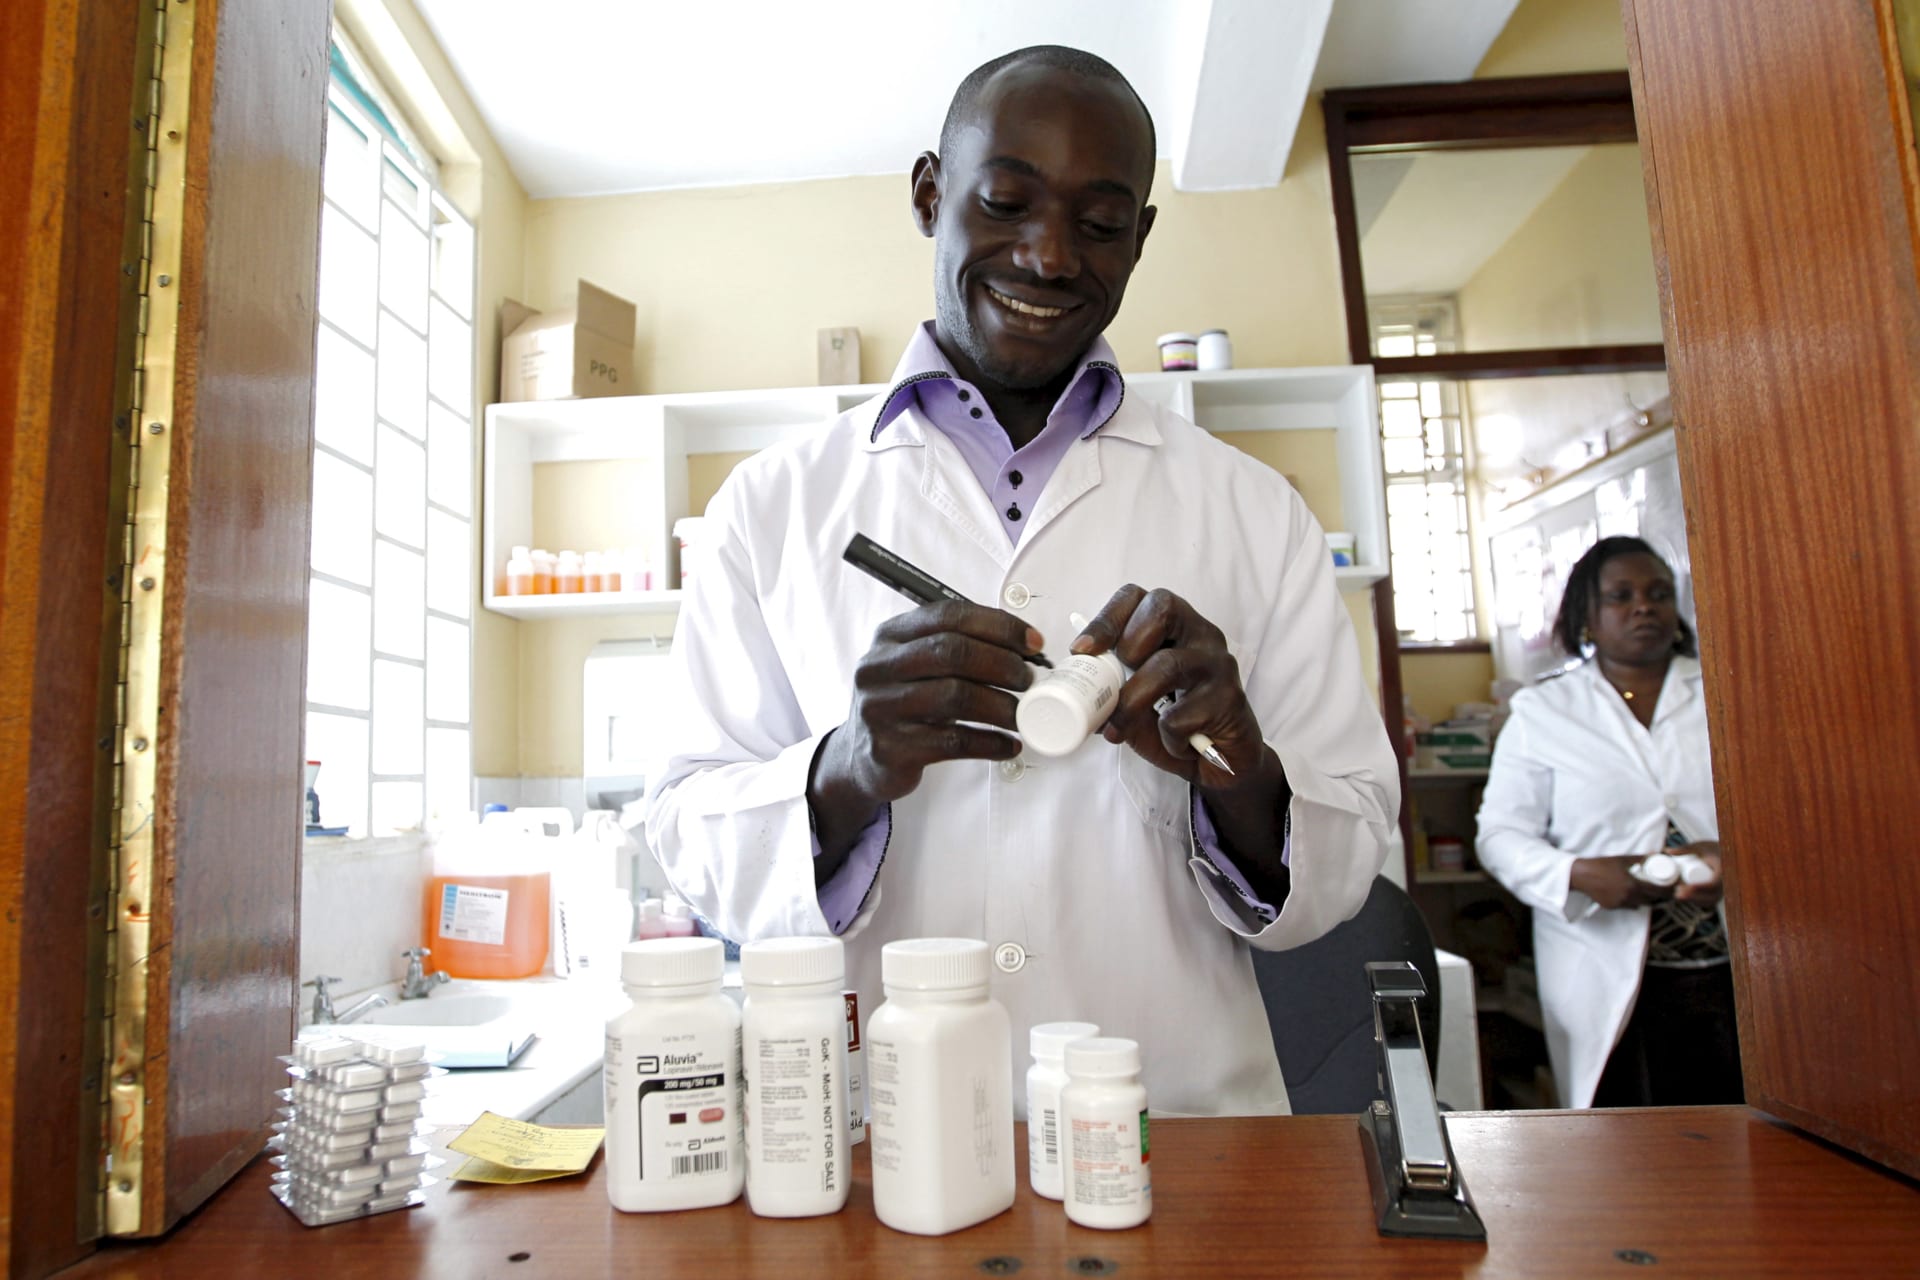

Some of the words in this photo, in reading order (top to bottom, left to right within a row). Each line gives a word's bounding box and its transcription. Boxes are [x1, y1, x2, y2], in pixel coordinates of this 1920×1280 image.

[868, 543, 898, 563] marker
[821, 1038, 830, 1062] GoK
[664, 1080, 679, 1090] 200
[679, 1078, 704, 1089] mg/50
[705, 1077, 718, 1087] mg
[822, 1073, 832, 1103] MoH:
[823, 1106, 833, 1129] NOT
[824, 1134, 833, 1158] FOR
[825, 1161, 835, 1192] SALE
